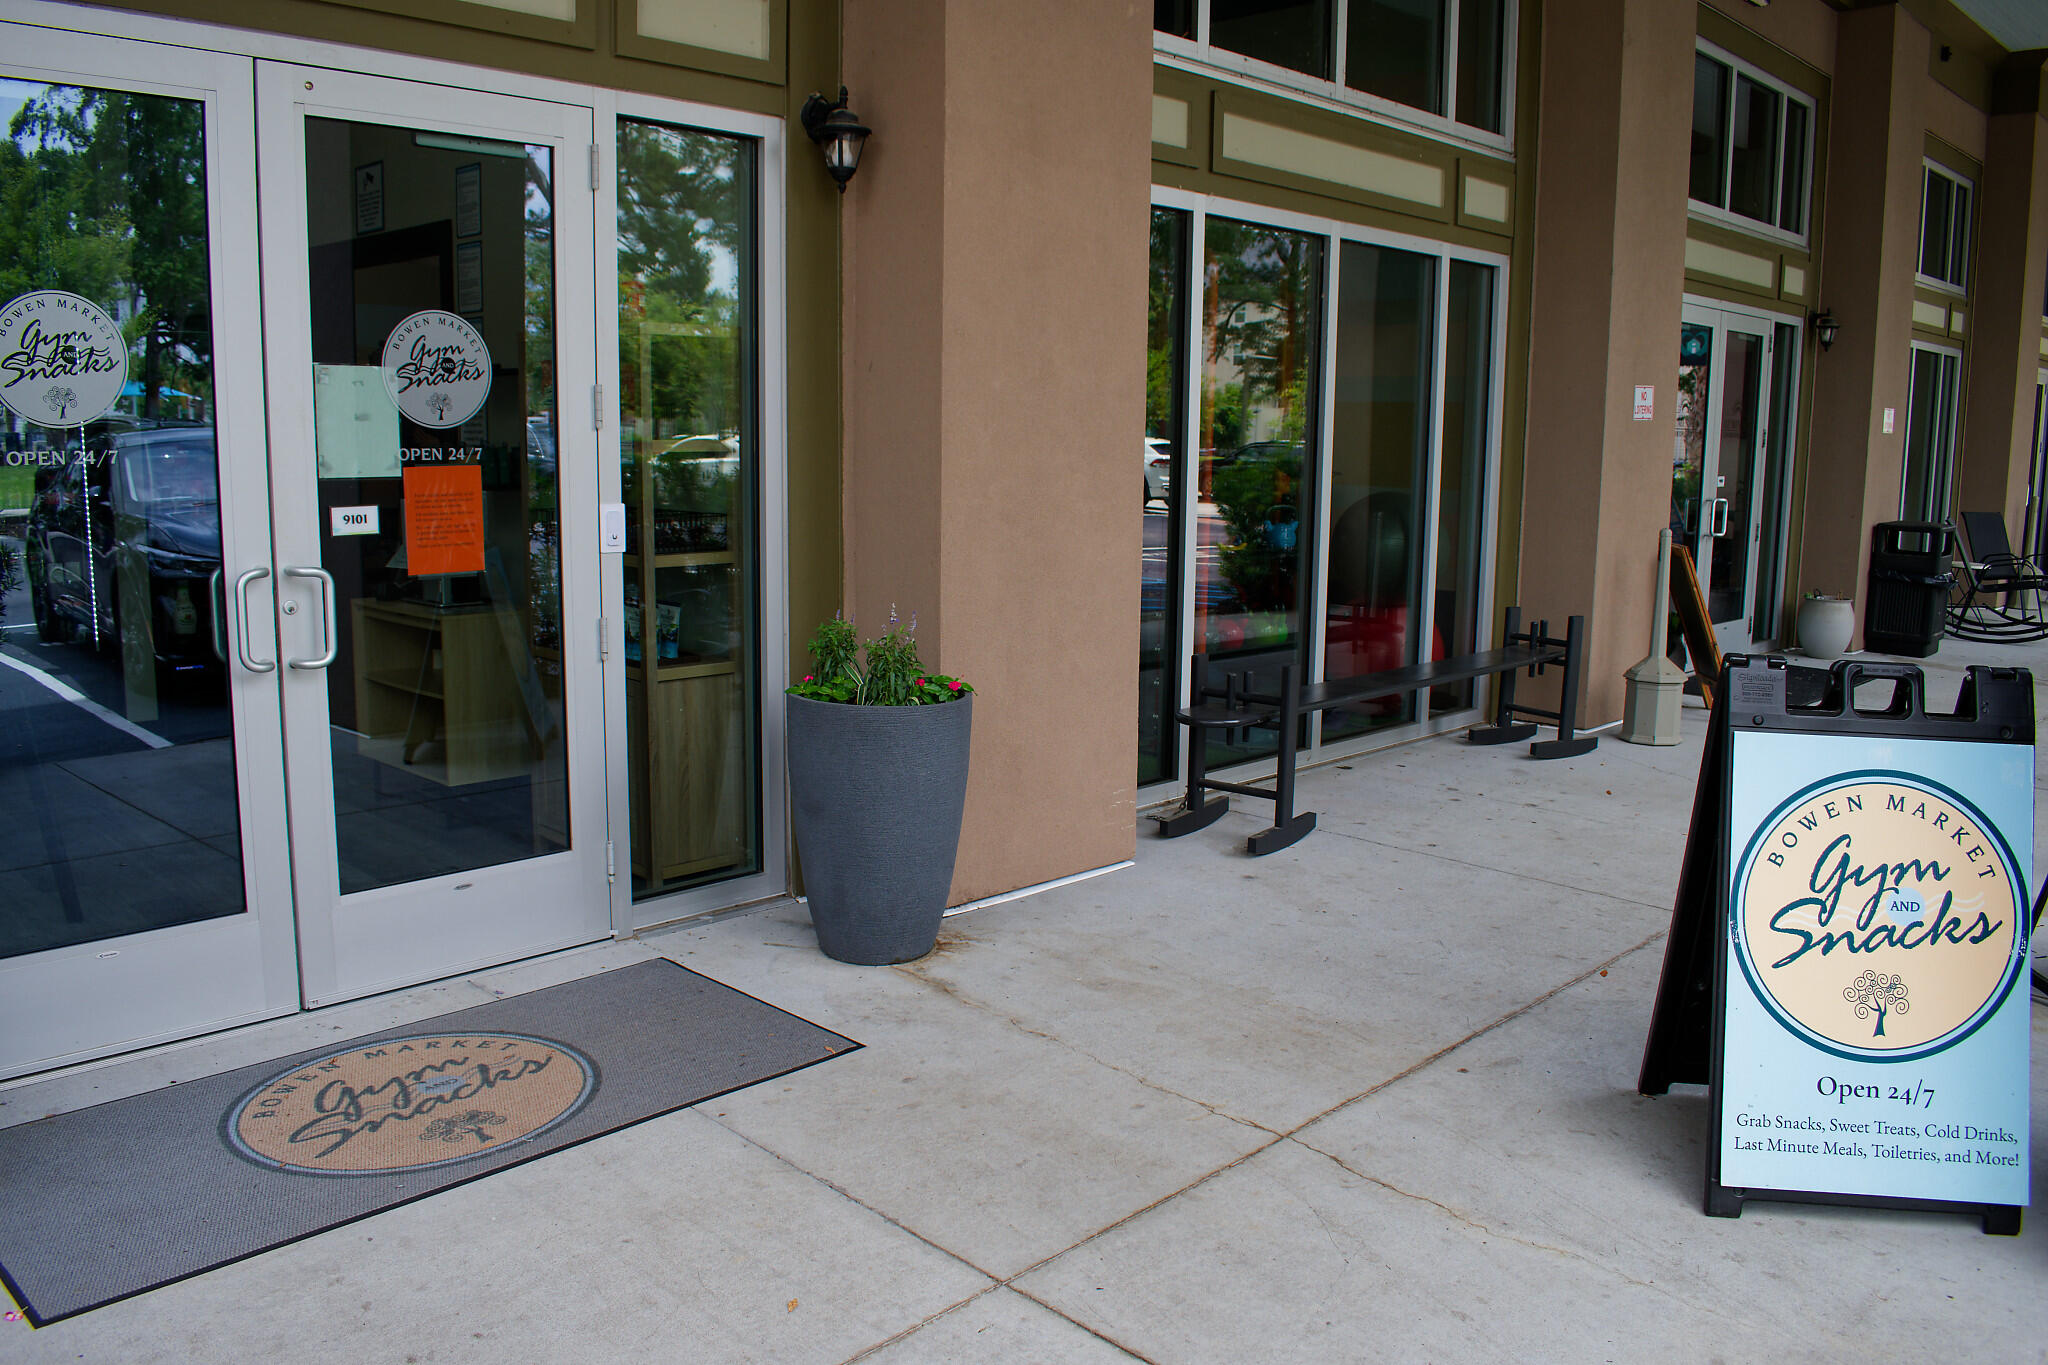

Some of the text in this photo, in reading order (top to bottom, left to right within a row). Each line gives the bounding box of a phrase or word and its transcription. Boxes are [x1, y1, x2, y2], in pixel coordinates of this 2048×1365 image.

[0, 299, 115, 340] BOWEN MARKET
[393, 317, 482, 353] BOWEN MARKET
[20, 318, 93, 367] Gym
[410, 335, 464, 376] Gym
[1, 346, 119, 388] Snacks
[396, 358, 486, 394] Snacks
[6, 449, 119, 468] OPEN 24/7
[399, 447, 483, 464] OPEN 24/7
[343, 514, 368, 524] 9101
[1767, 794, 1996, 880] BOWEN MARKET
[1809, 834, 1950, 931] Gym
[1890, 901, 1921, 913] AND
[1769, 890, 2003, 969] Snacks
[252, 1040, 519, 1119] BOWEN MARKET
[314, 1057, 469, 1122] Gym
[1817, 1075, 1935, 1109] Open 24/7
[288, 1056, 553, 1160] Snacks
[1736, 1112, 2018, 1145] Grab Snacks, Sweet Treats, Cold Drinks,
[1733, 1136, 2020, 1167] Last Minute Meals, Toiletries, and More!
